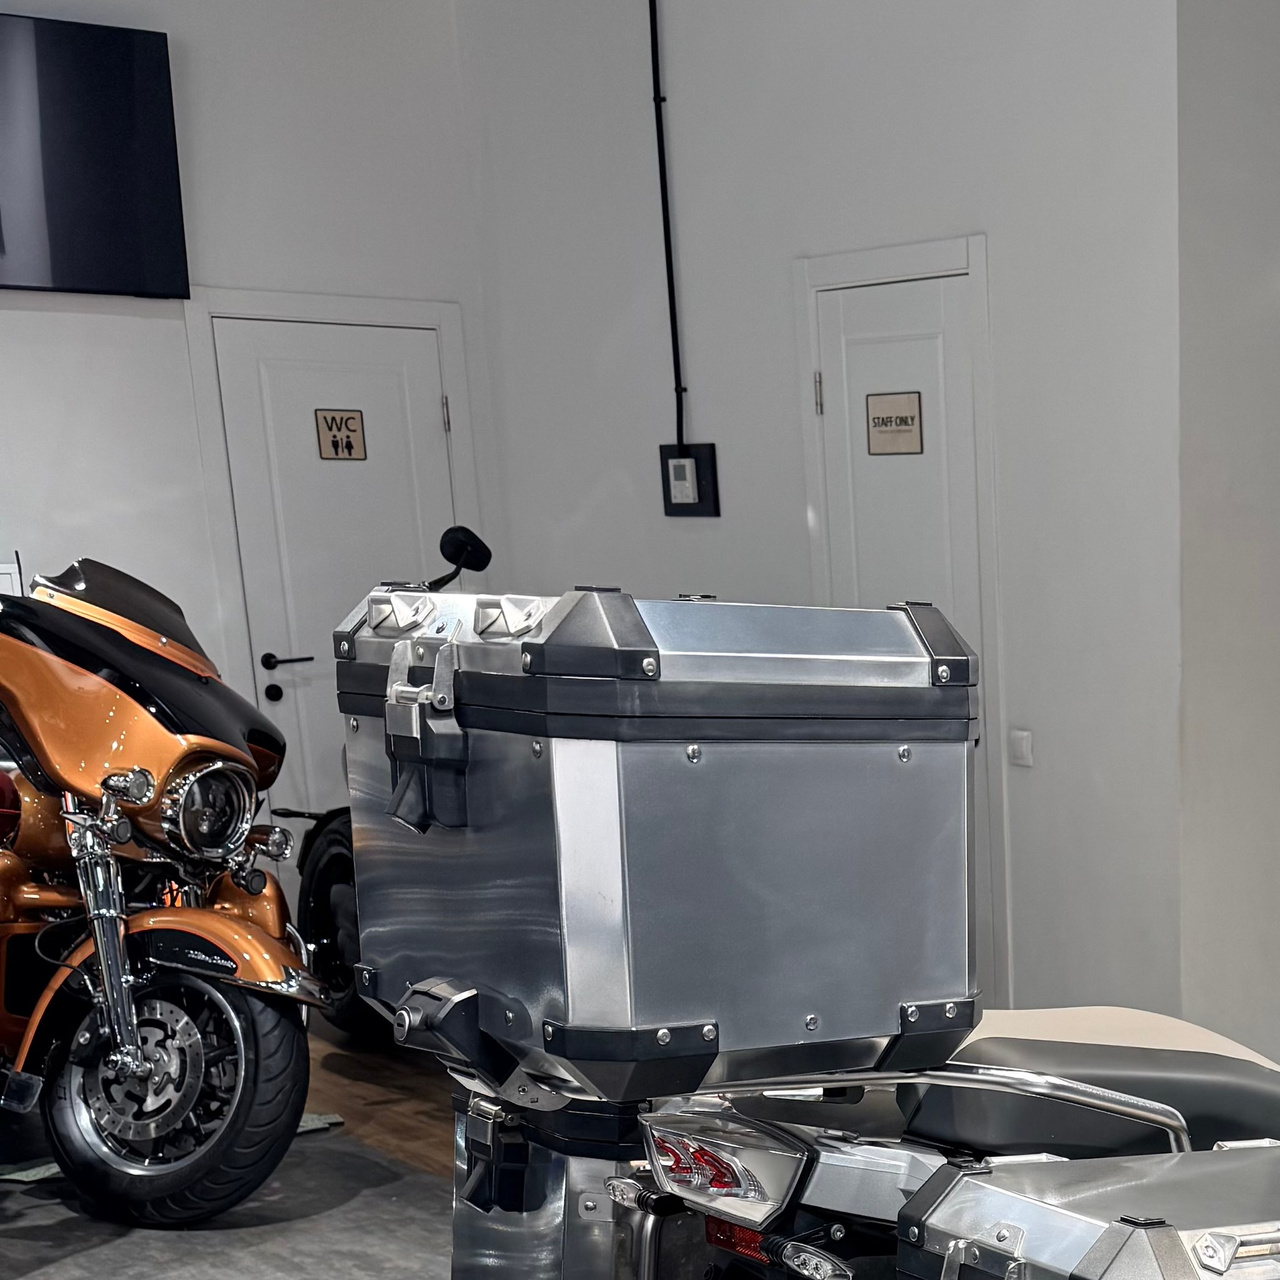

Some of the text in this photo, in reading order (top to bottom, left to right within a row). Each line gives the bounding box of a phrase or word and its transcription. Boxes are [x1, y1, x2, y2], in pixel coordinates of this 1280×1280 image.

[323, 415, 357, 433] WC
[872, 415, 916, 428] STAFF ONLY
